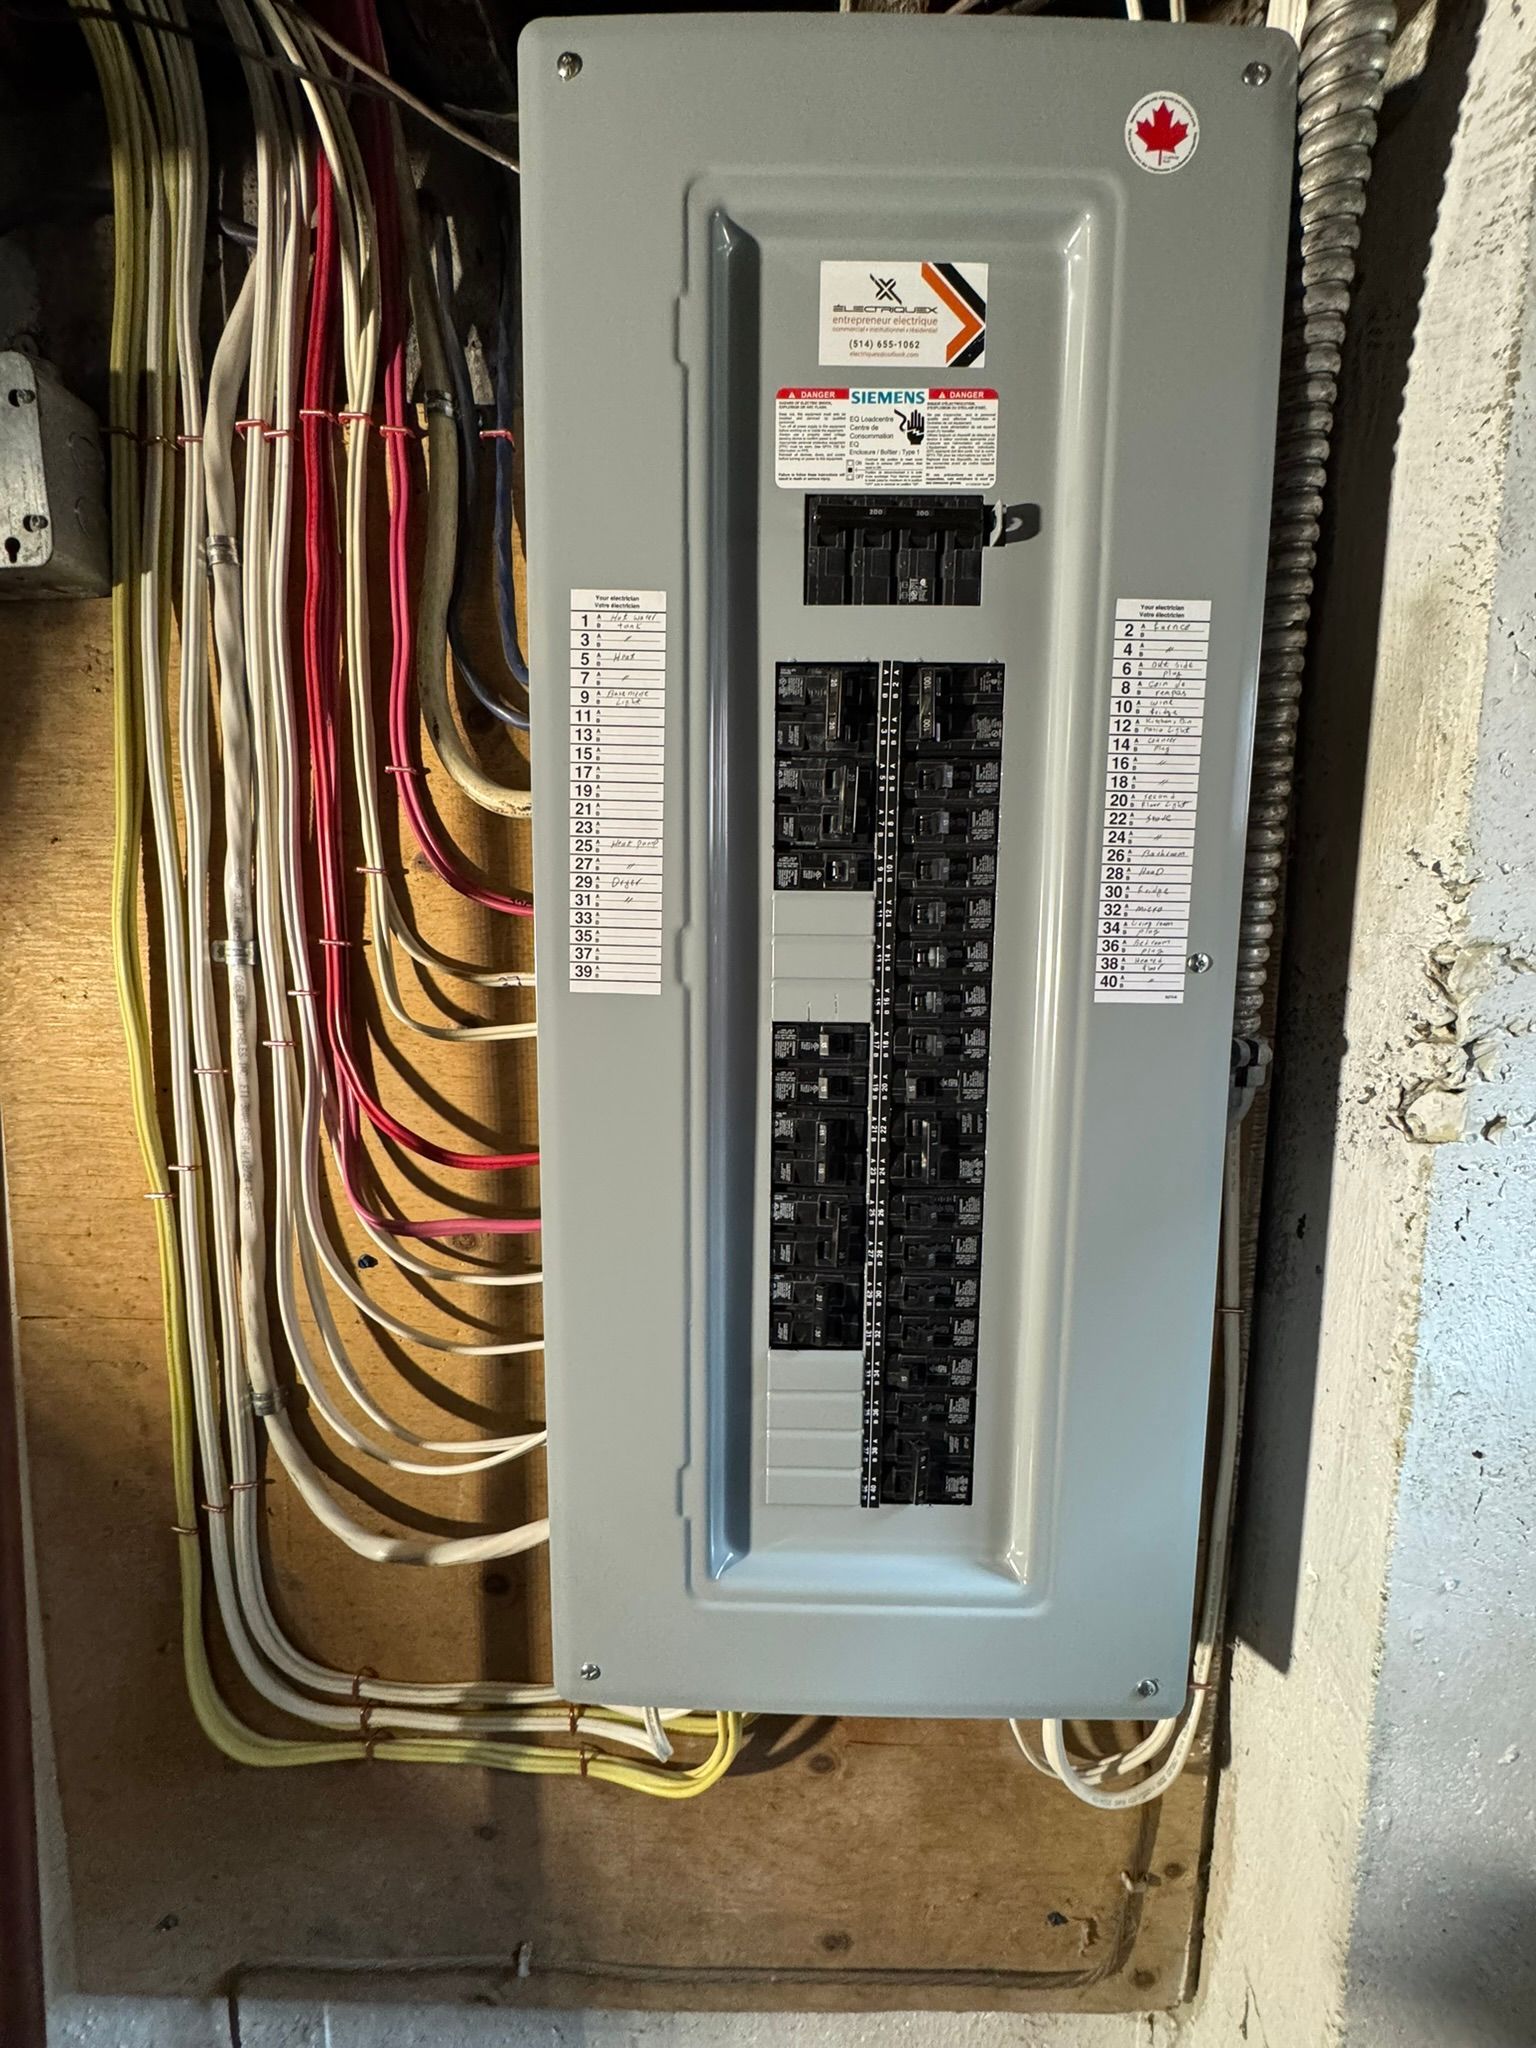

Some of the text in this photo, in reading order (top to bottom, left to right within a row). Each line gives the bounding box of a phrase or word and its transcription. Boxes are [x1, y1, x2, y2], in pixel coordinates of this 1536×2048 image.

[833, 317, 890, 325] entrepreneur
[849, 339, 920, 349] (514) 655-1062
[851, 391, 925, 404] SIEMENS
[581, 615, 587, 627] 1
[1124, 624, 1134, 636] 2
[581, 634, 590, 646] 3
[1124, 643, 1132, 656] 4
[581, 653, 590, 665] 5
[1123, 662, 1131, 675] 6
[581, 672, 590, 684] 7
[923, 676, 931, 689] 100
[1122, 681, 1130, 694] 8
[581, 691, 590, 703] 9
[1116, 700, 1132, 713] 10
[576, 710, 590, 722] 11
[923, 719, 931, 732] 100
[1114, 719, 1131, 732] 12
[576, 729, 592, 741] 13
[1114, 738, 1130, 750] 14
[576, 748, 592, 760] 15
[1112, 757, 1129, 770] 16
[576, 766, 592, 778] 17
[1111, 776, 1128, 788] 18
[576, 785, 592, 797] 19
[1110, 794, 1128, 806] 20
[576, 803, 590, 815] 21
[1109, 812, 1127, 825] 22
[576, 821, 592, 833] 23
[1108, 831, 1125, 843] 24
[576, 839, 592, 852] 25
[1107, 849, 1124, 861] 26
[576, 858, 592, 870] 27
[1106, 867, 1123, 880] 28
[576, 876, 592, 888] 29
[1105, 886, 1122, 898] 30
[576, 894, 590, 906] 31
[1104, 904, 1121, 916] 32
[576, 912, 592, 924] 33
[1103, 922, 1120, 934] 34
[576, 930, 592, 942] 35
[1102, 940, 1119, 952] 36
[576, 947, 592, 960] 37
[1101, 957, 1118, 970] 38
[576, 965, 592, 977] 39
[1100, 975, 1117, 987] 40
